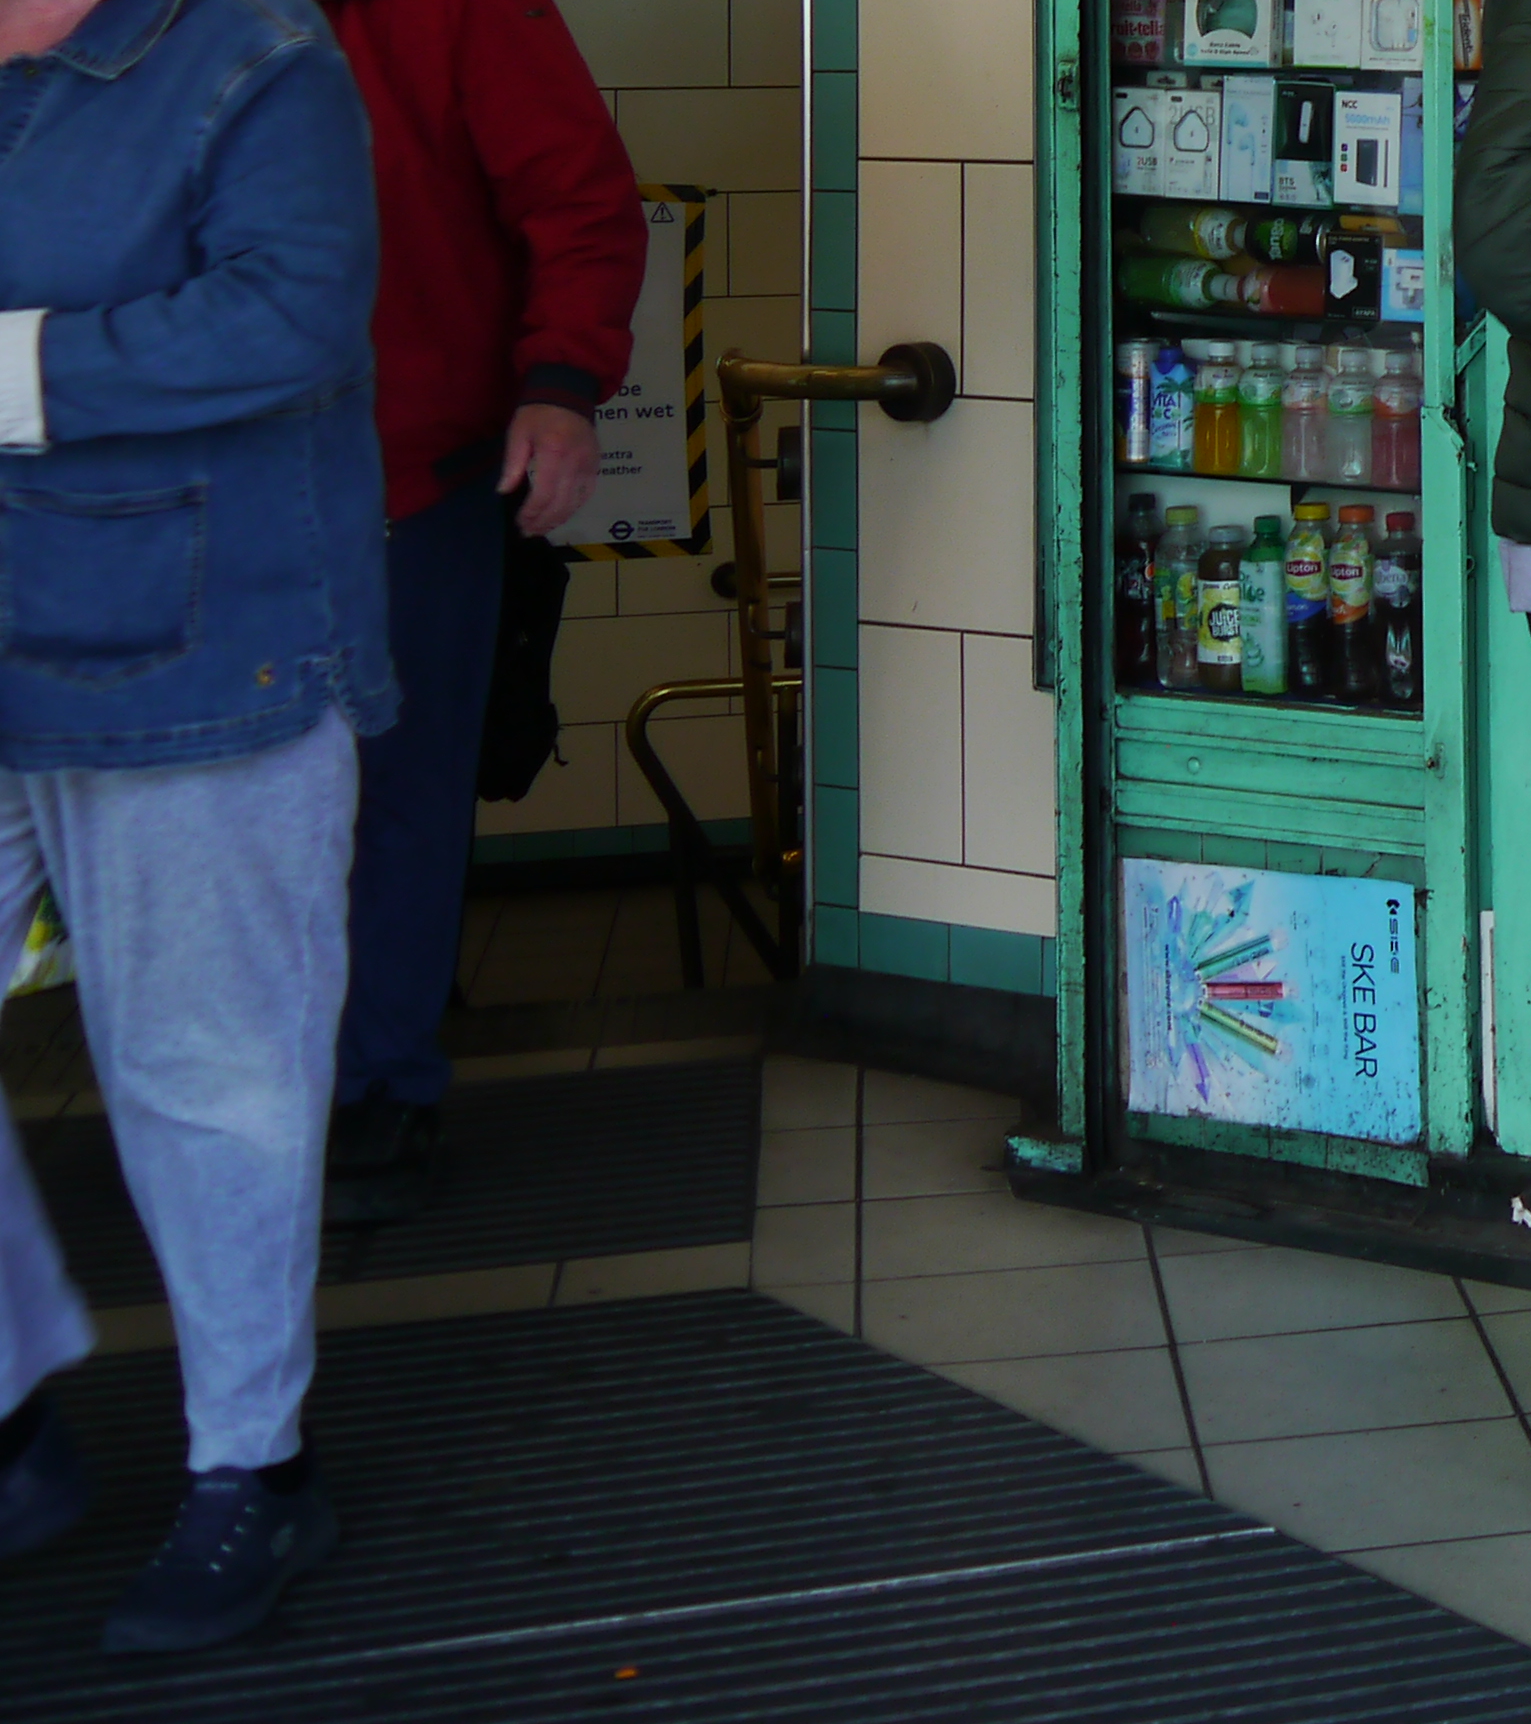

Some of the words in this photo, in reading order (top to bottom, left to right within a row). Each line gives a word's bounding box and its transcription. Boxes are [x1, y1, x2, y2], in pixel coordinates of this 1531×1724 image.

[635, 404, 674, 419] wet
[1350, 942, 1376, 1005] SKE
[1352, 1011, 1378, 1078] BAR
